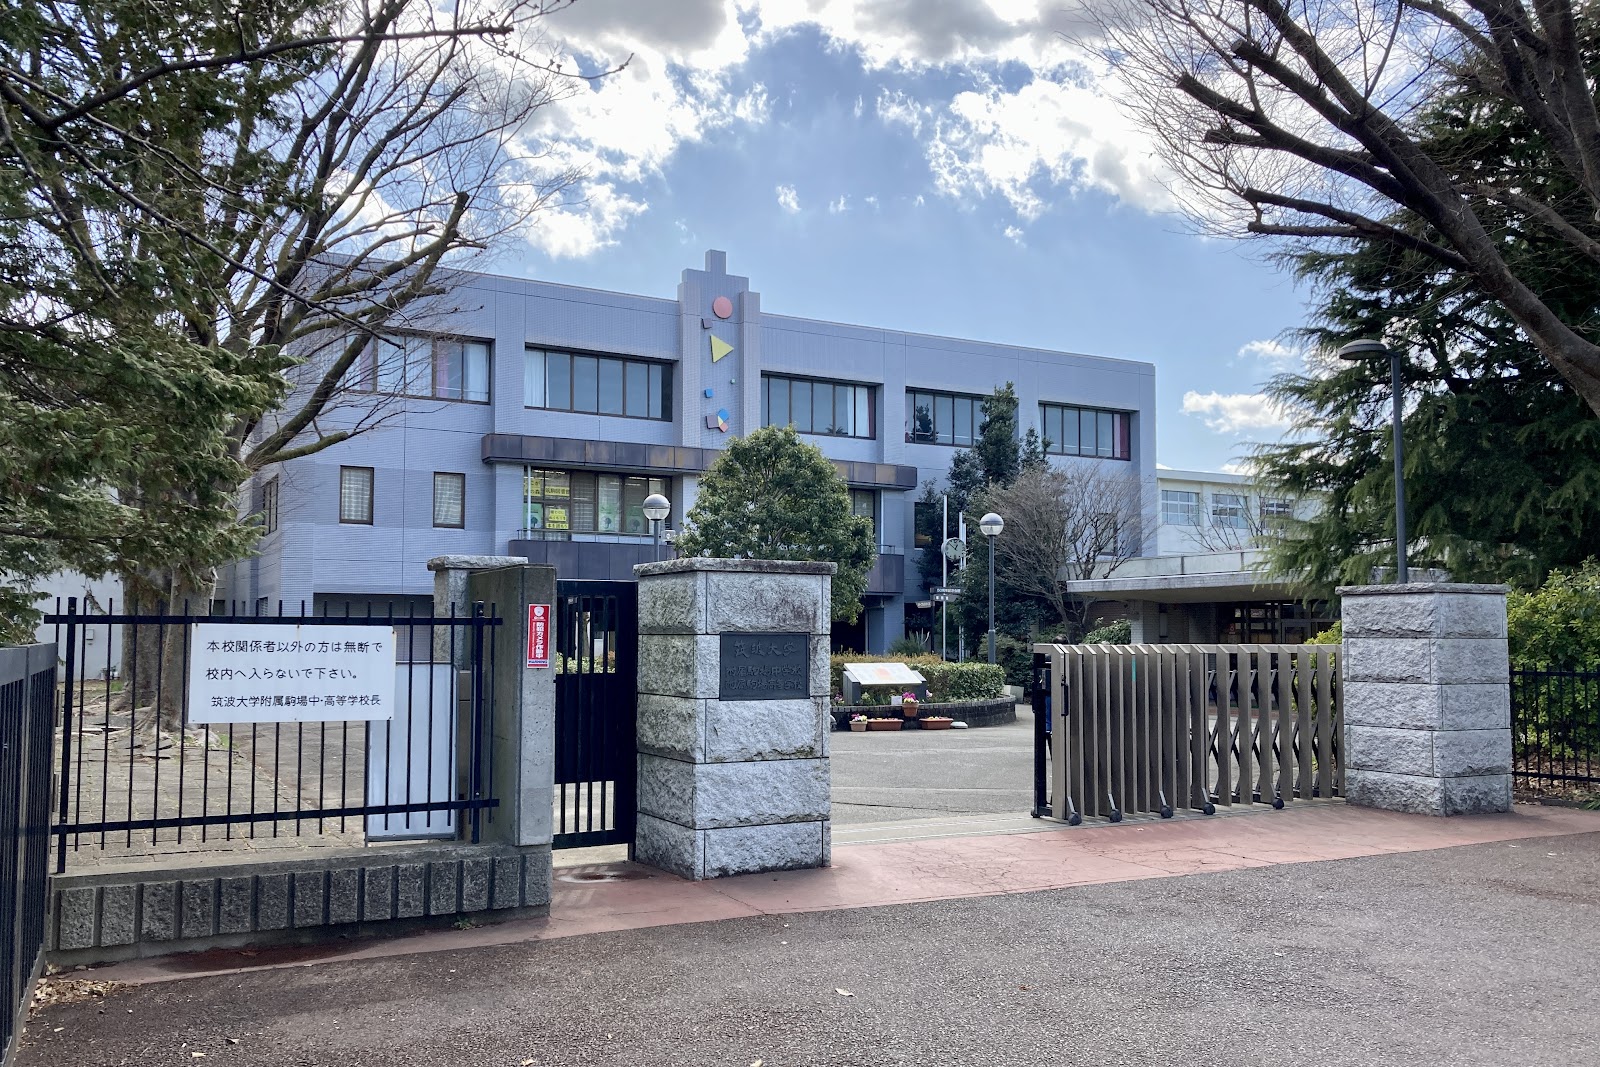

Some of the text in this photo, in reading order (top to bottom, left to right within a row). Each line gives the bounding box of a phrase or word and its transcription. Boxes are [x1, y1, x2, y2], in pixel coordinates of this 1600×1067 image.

[206, 639, 383, 653] 本校関係者以外の方は無断で
[205, 667, 358, 681] 校内へ入らないで下さい。
[211, 694, 382, 708] 筑波大学附属駒場中・高等学校長
